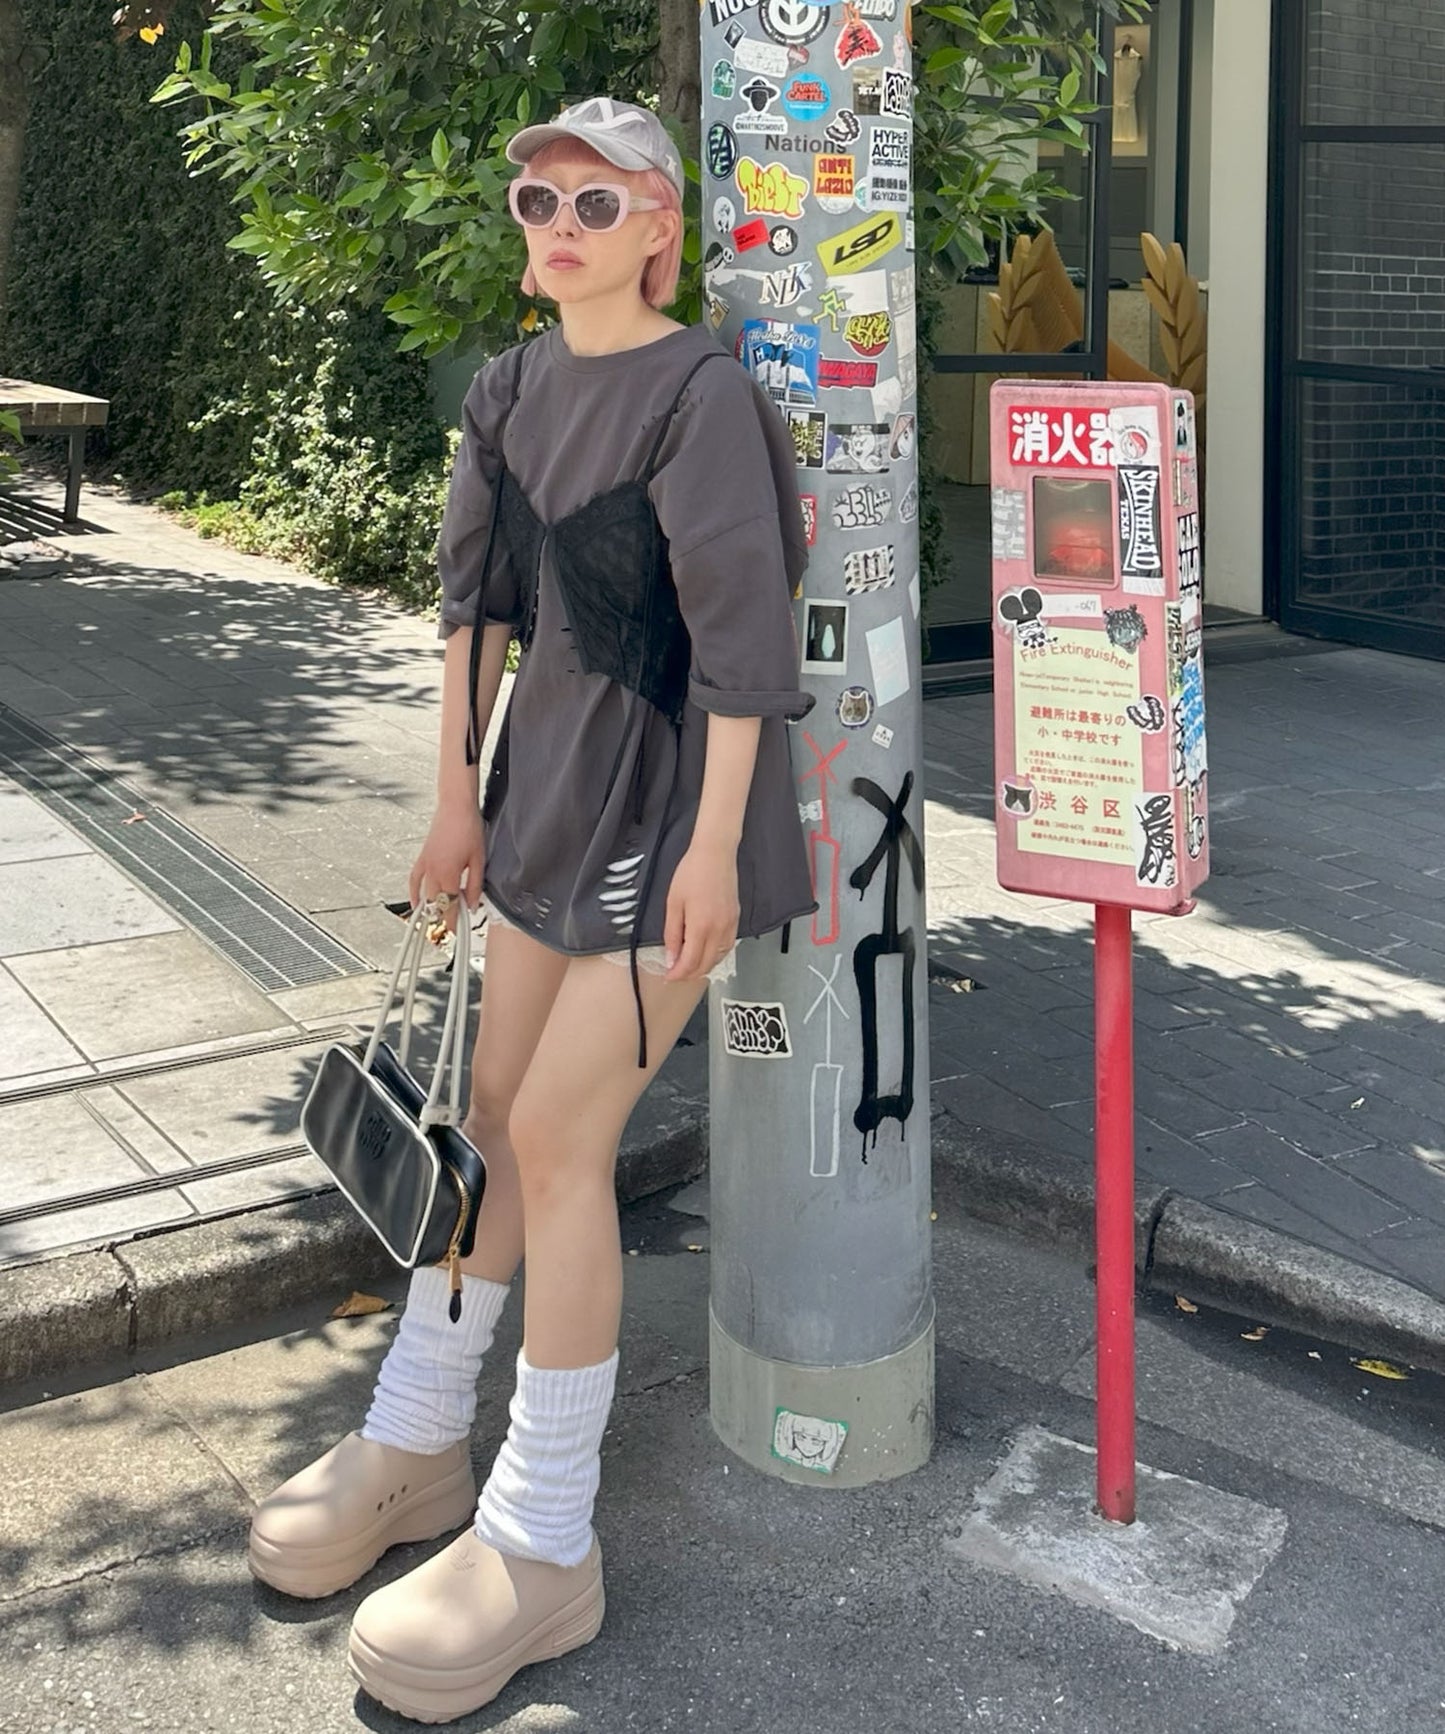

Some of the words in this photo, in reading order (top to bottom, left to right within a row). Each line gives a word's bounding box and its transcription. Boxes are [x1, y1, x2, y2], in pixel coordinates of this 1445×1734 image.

[786, 90, 828, 102] CARTEL
[792, 81, 820, 92] FUNK
[873, 129, 908, 144] HYPER
[871, 144, 908, 159] ACTIVE
[818, 158, 852, 174] ANTI
[816, 177, 853, 194] LAZIO
[833, 219, 893, 265] LSD
[1120, 499, 1131, 540] TEXAS
[1133, 468, 1161, 570] SKINHEAD
[1020, 648, 1046, 662] Fire
[1050, 642, 1133, 670] Extinguisher
[1030, 705, 1126, 727] 避難所は最寄りの
[1037, 725, 1122, 746] 小・中学校です
